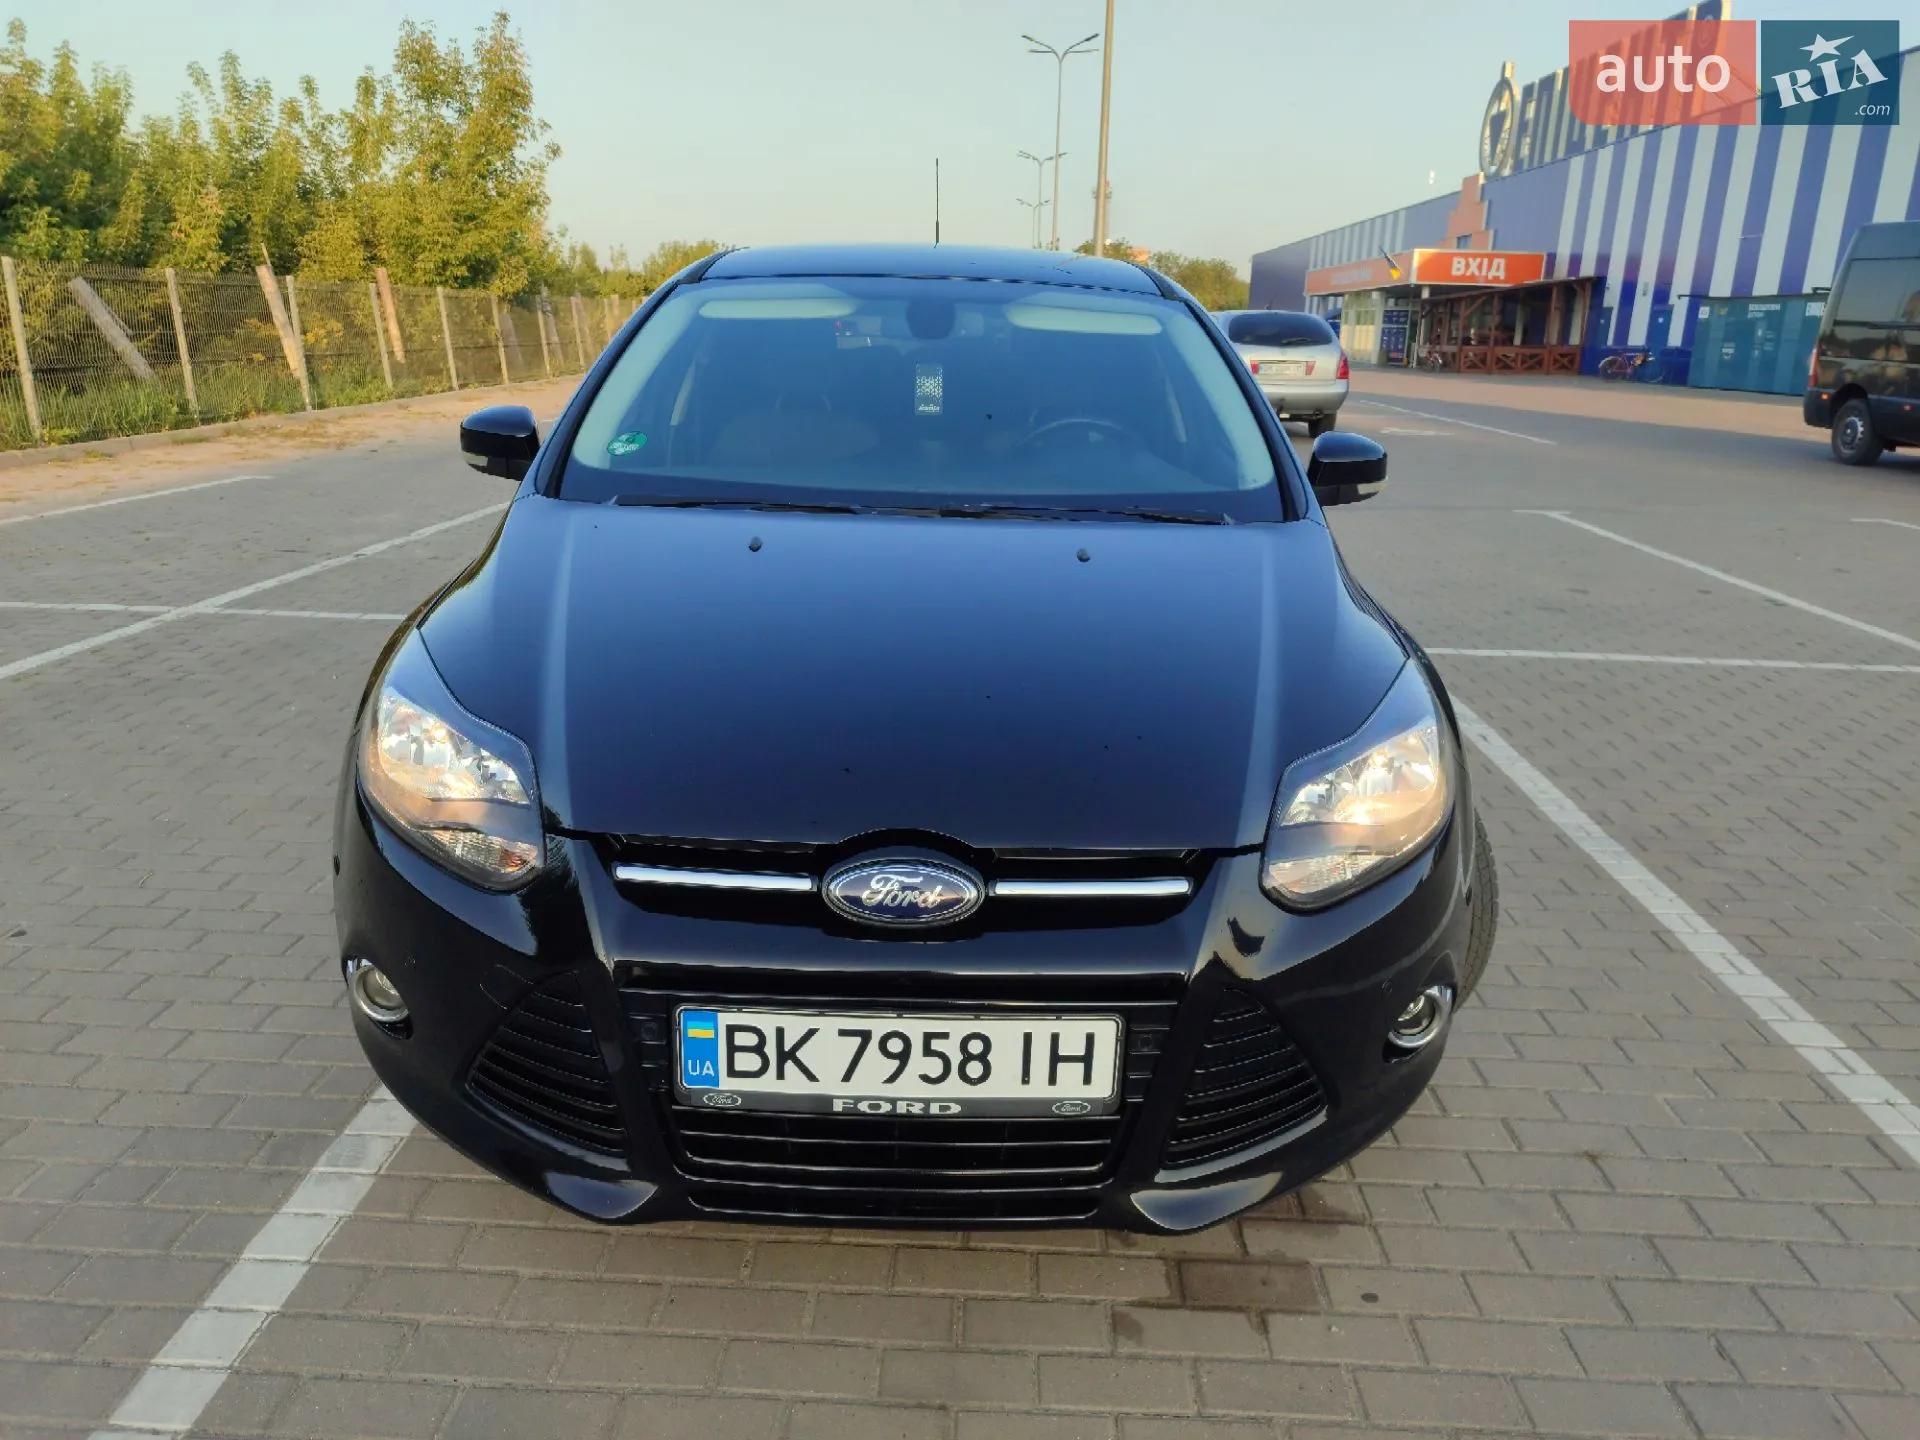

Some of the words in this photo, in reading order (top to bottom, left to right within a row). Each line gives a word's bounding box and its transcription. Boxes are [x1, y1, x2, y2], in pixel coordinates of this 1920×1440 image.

[1451, 256, 1507, 280] ВХІД
[861, 873, 943, 909] Ford
[725, 1023, 820, 1083] BK
[837, 1028, 993, 1086] 7958
[1021, 1031, 1095, 1087] IH
[687, 1059, 715, 1077] UA
[831, 1097, 963, 1115] FORD
